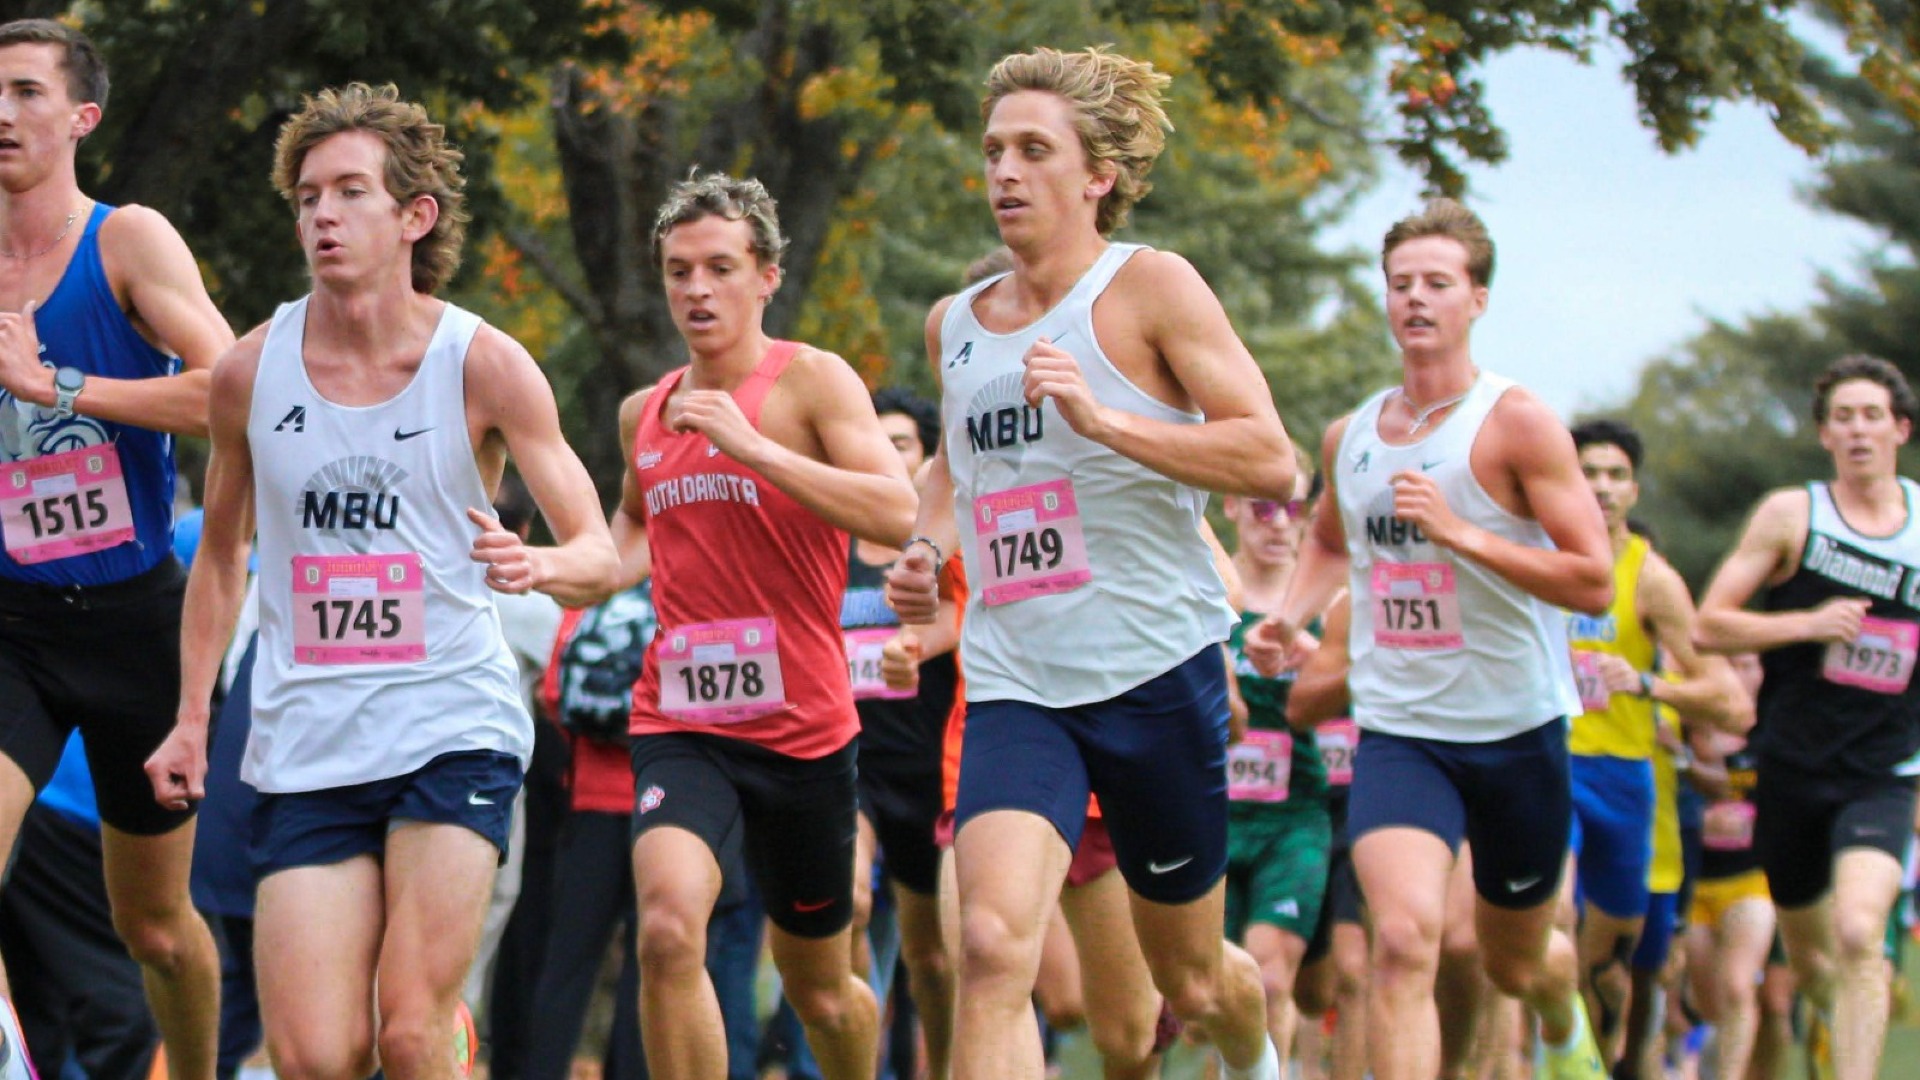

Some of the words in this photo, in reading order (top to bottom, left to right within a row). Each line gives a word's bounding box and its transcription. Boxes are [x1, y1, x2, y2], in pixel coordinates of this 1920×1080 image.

[967, 404, 1043, 454] MBU
[22, 487, 109, 538] 1515
[303, 490, 400, 529] MBU
[646, 478, 681, 516] UTH
[681, 473, 760, 506] DAKOTA
[989, 528, 1064, 577] 1749
[1805, 534, 1904, 600] Diamond
[312, 599, 402, 640] 1745
[1382, 598, 1441, 630] 1751
[679, 661, 765, 702] 1878
[1843, 646, 1902, 677] 1973
